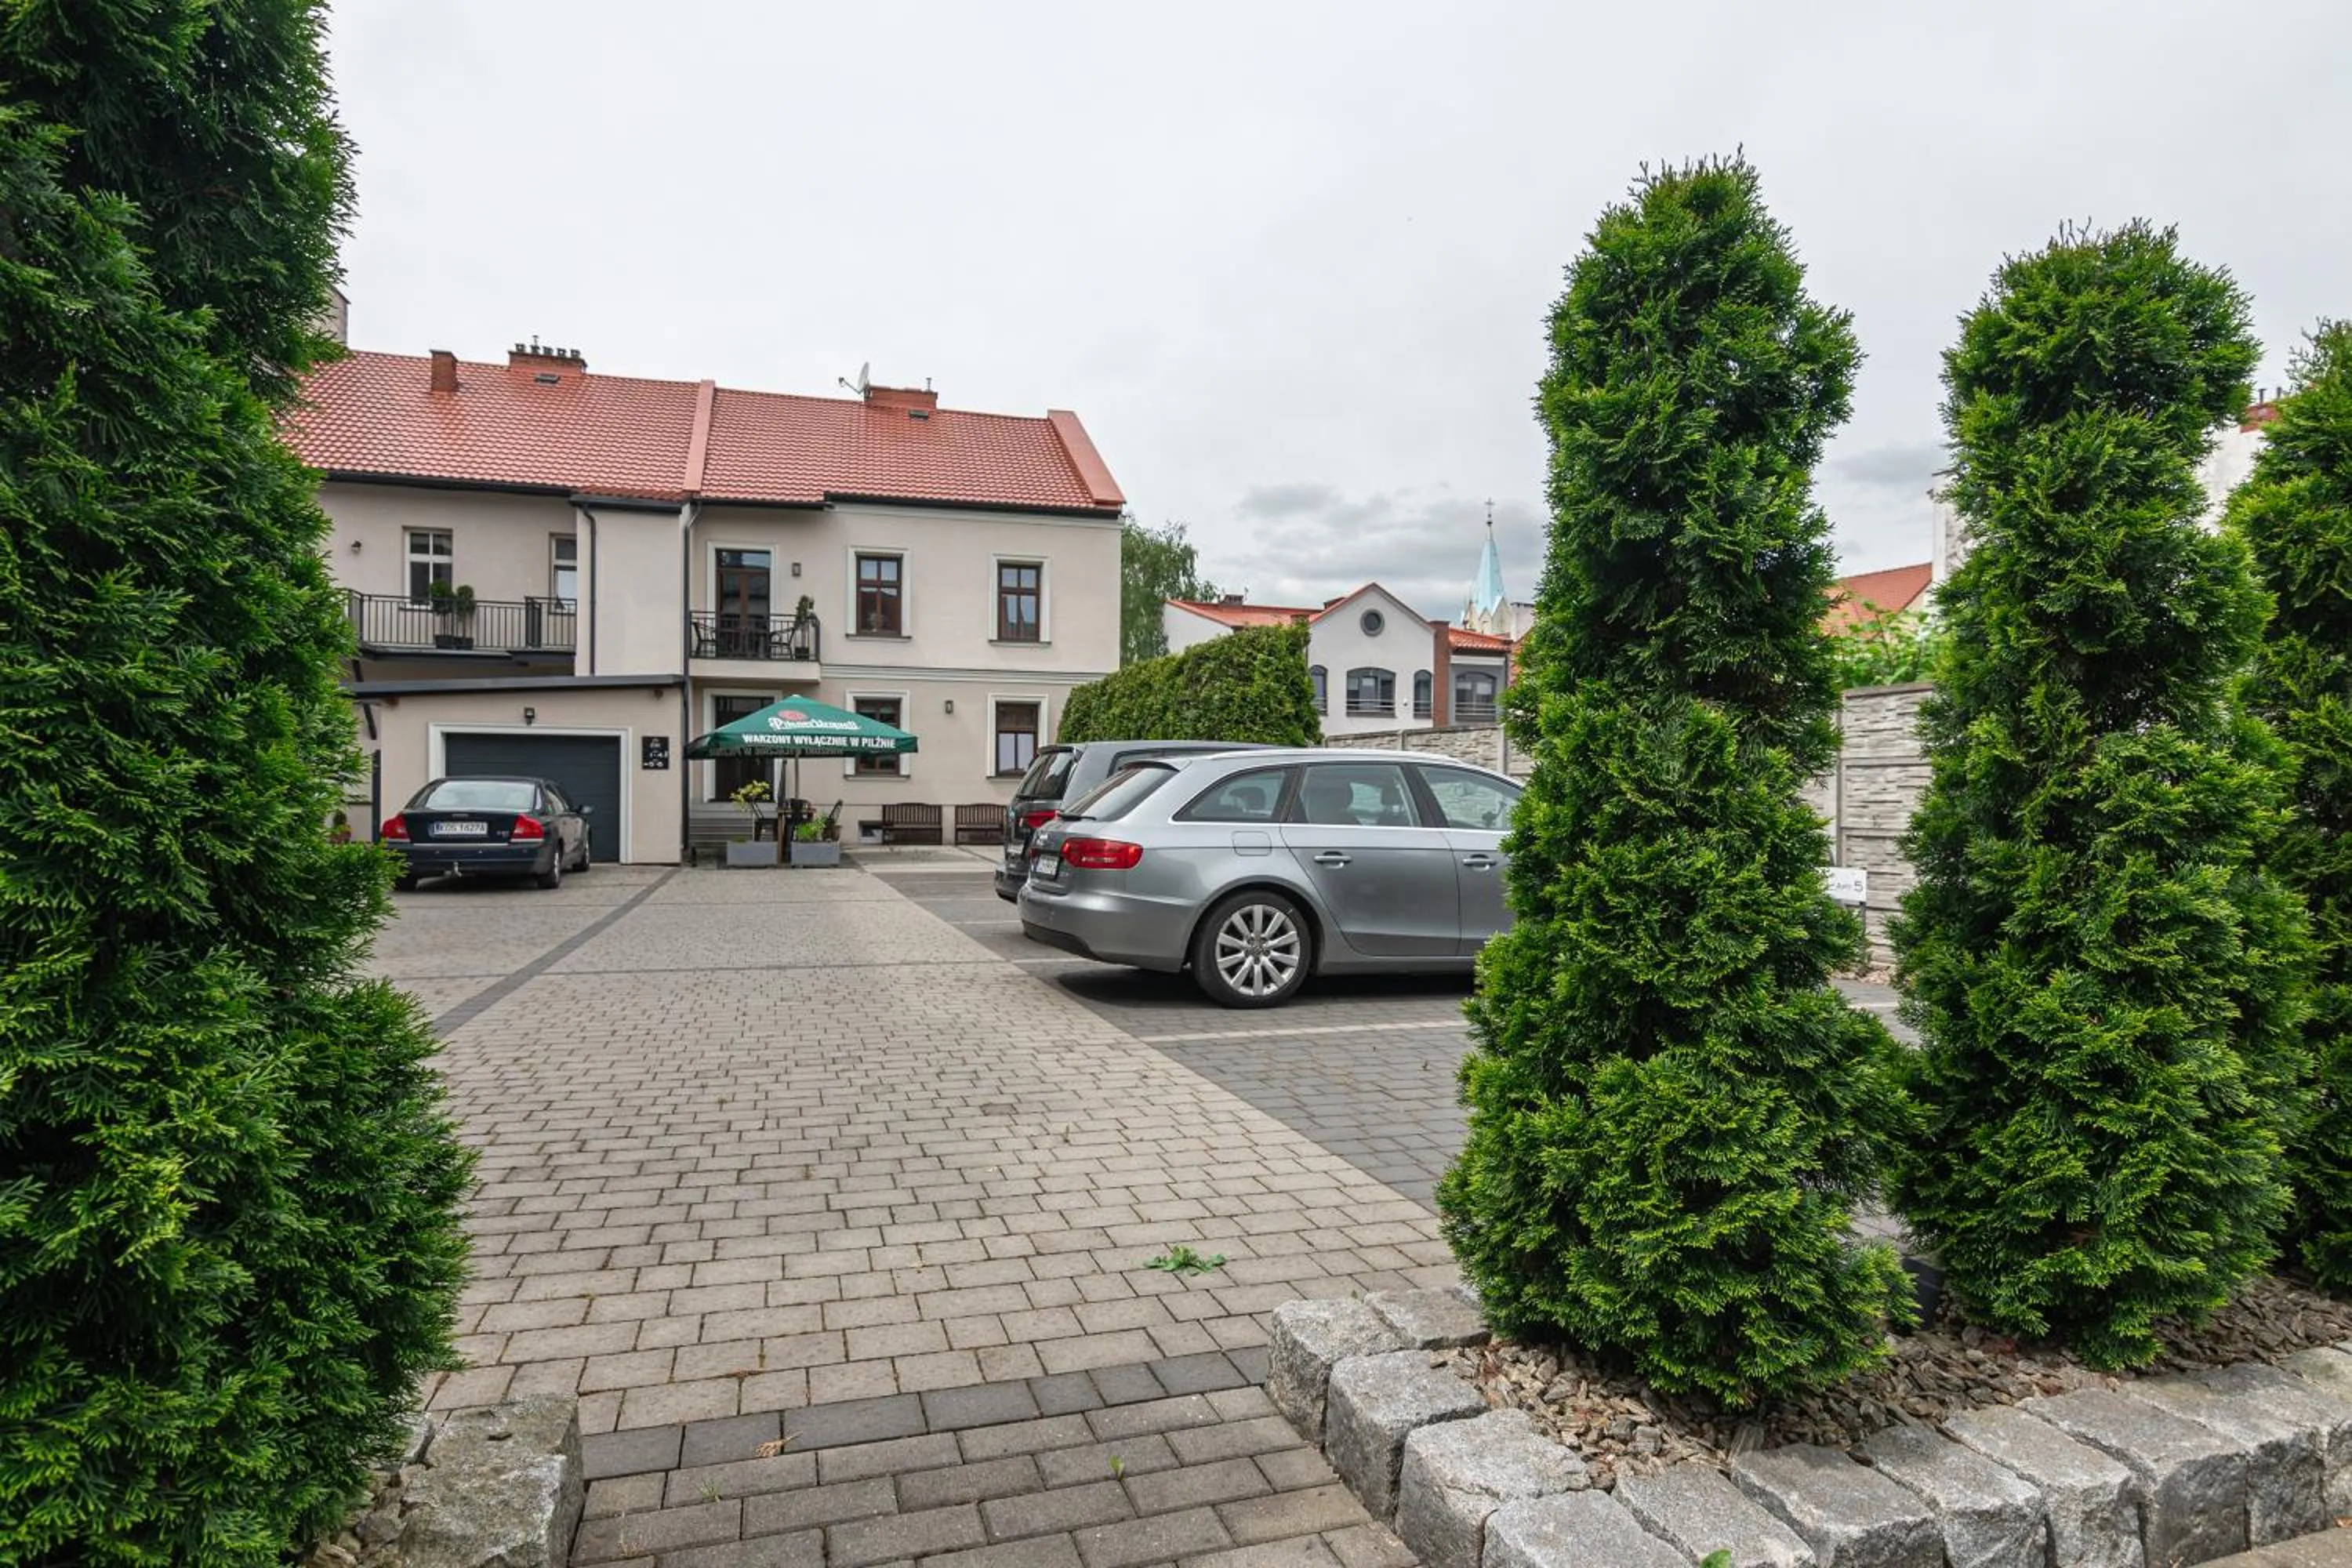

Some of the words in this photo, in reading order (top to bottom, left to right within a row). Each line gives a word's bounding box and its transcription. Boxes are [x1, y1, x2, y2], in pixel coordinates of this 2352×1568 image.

[742, 734, 791, 744] WARZONY
[793, 735, 848, 746] WYŁĄCZNIE
[849, 736, 860, 747] W
[862, 735, 896, 749] PILŹNIE
[1854, 880, 1864, 892] 5
